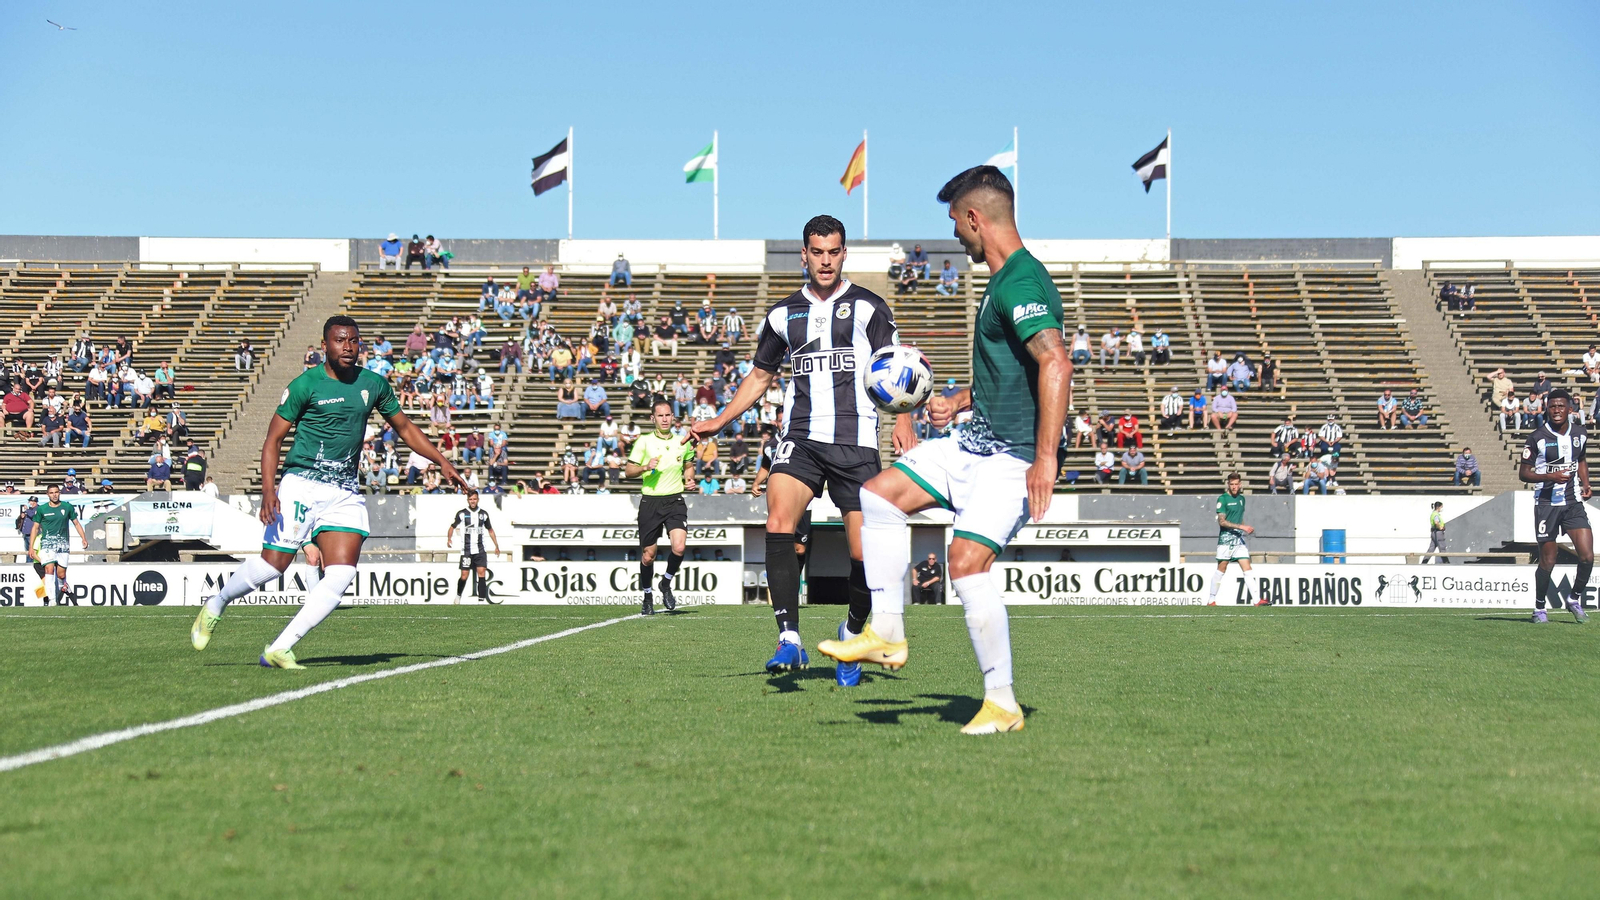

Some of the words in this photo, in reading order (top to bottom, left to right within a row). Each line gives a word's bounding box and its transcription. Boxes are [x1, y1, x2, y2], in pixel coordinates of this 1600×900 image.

[791, 354, 856, 376] LOTUS
[776, 441, 796, 459] 0
[152, 501, 193, 510] BALONA
[164, 525, 180, 533] 1912
[1538, 519, 1547, 534] 6
[529, 529, 585, 539] LEGEA
[602, 529, 641, 539] LEG
[1035, 529, 1090, 539] LEGEA
[1107, 529, 1162, 539] LEGEA
[135, 579, 164, 592] linea
[369, 571, 449, 602] Monje
[519, 566, 597, 599] Rojas
[609, 566, 718, 593] Caillo
[1003, 566, 1081, 600] Rojas
[1094, 567, 1204, 593] Carrillo
[1236, 577, 1293, 605] ZBAL
[1298, 572, 1362, 606] BAÑOS
[1421, 576, 1437, 590] El
[1441, 577, 1529, 593] Guadarnés
[567, 596, 643, 606] CONSTRUCCIONES
[655, 596, 683, 606] OAS
[685, 596, 716, 606] CIVILES
[1051, 597, 1128, 606] CONSTRUCCIONES
[1132, 597, 1138, 606] Y
[1140, 597, 1169, 606] OBRAS
[1171, 597, 1203, 606] CIVILES
[1433, 597, 1517, 605] RESTAURANTE
